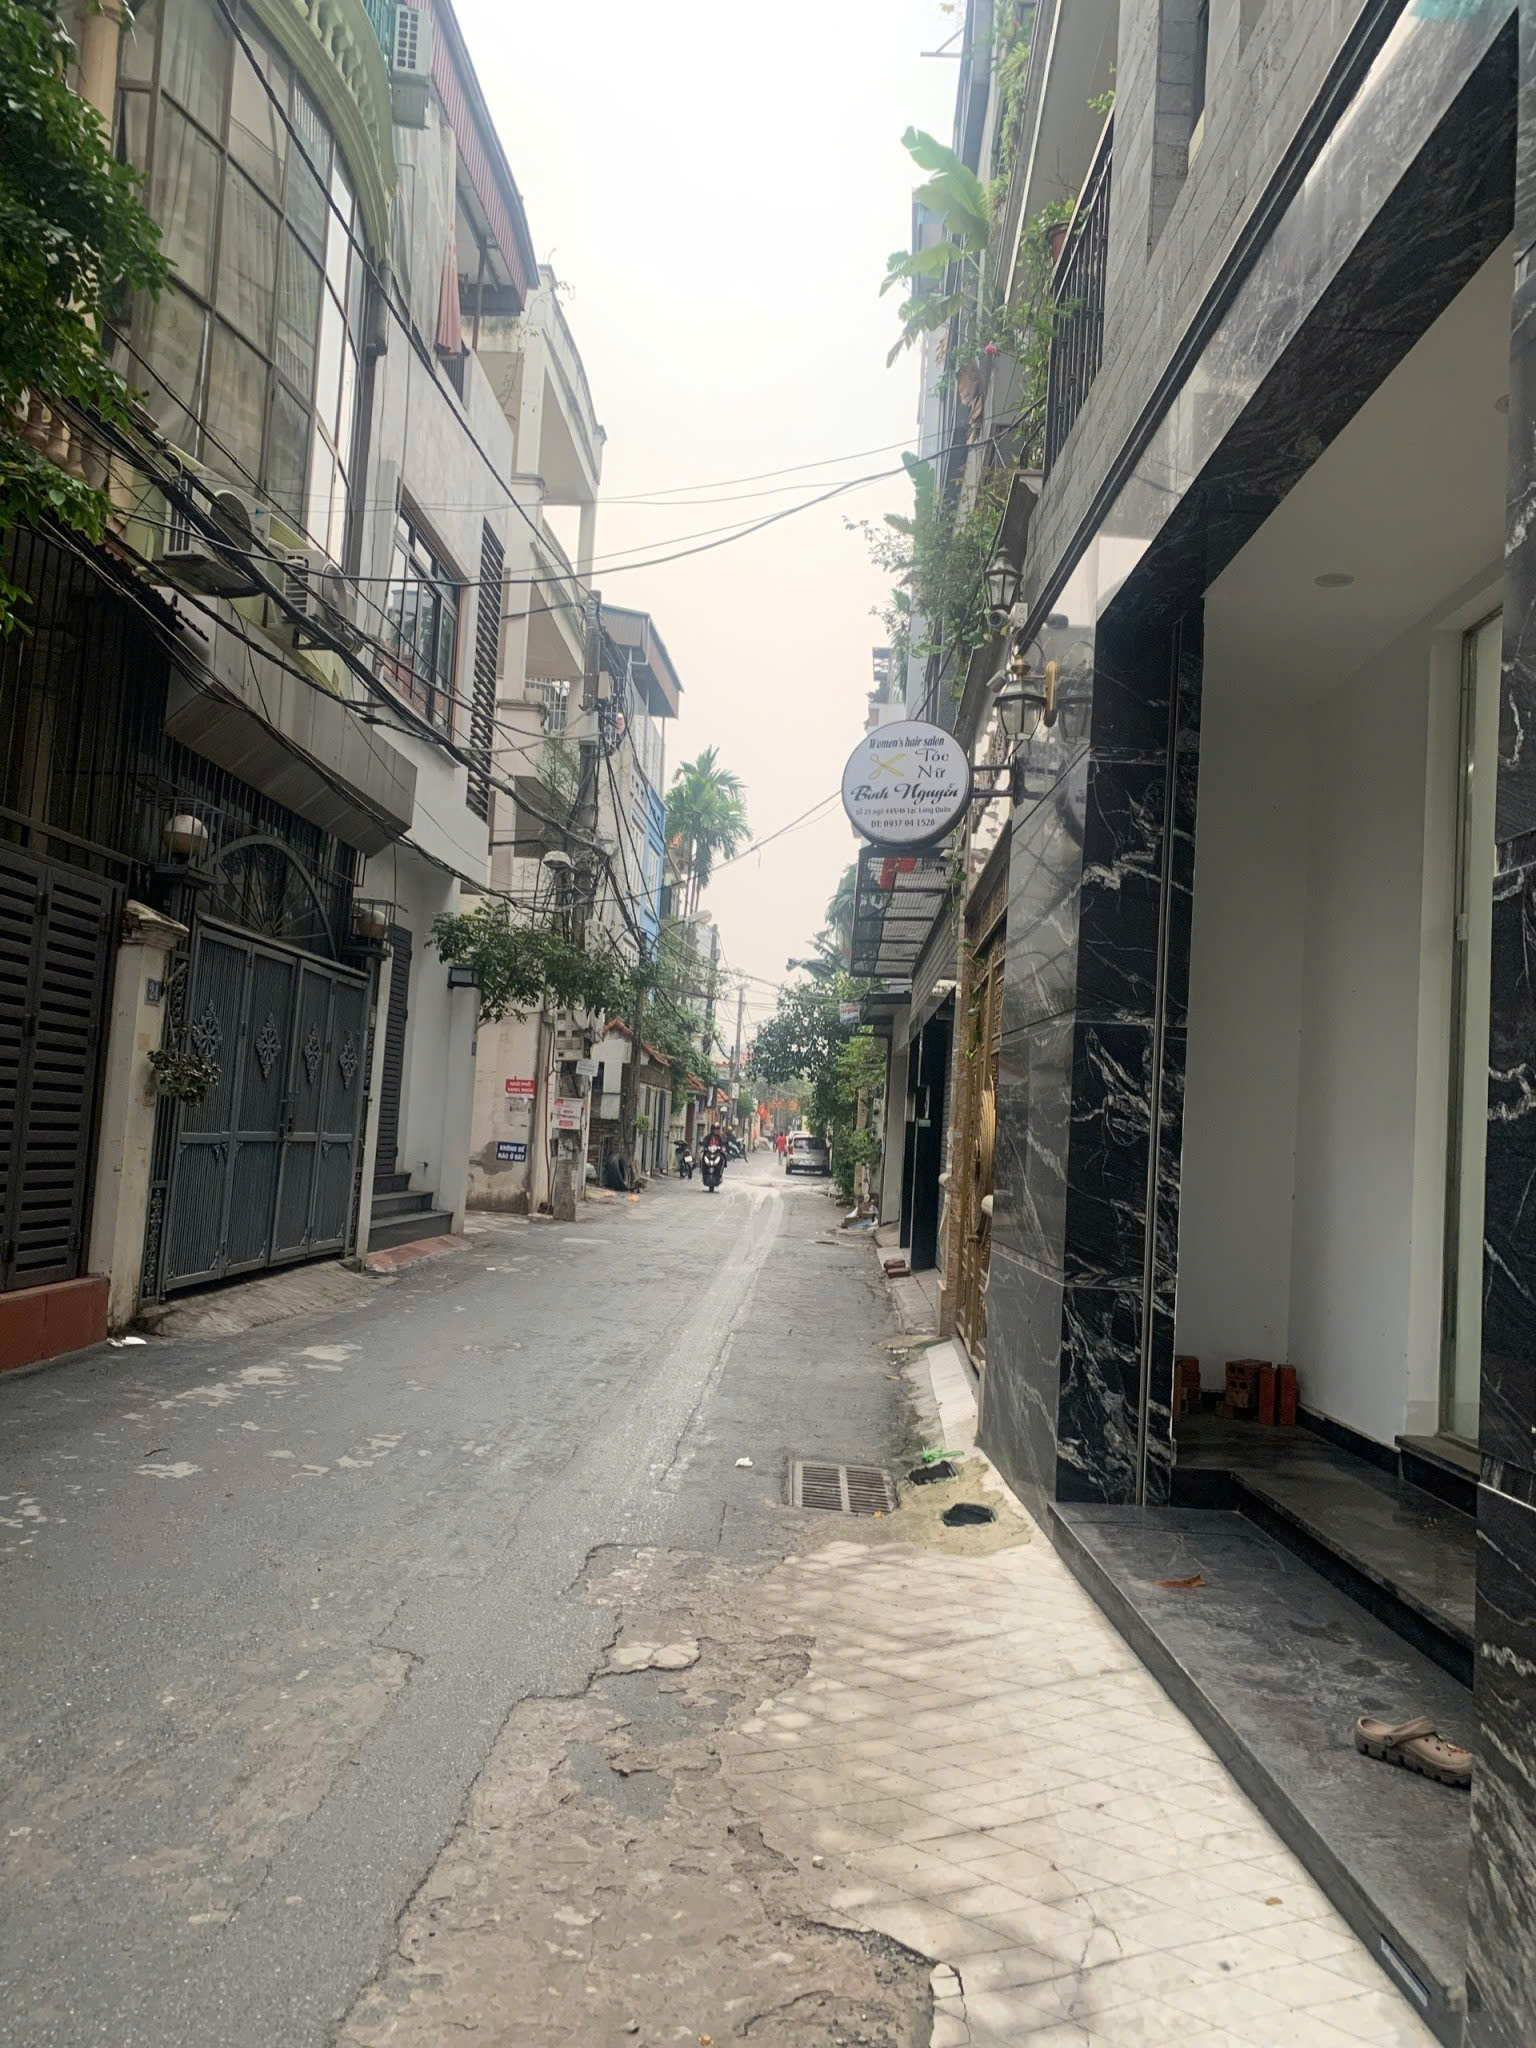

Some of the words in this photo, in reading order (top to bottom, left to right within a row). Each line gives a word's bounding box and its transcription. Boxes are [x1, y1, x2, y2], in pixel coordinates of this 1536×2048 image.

[869, 737, 904, 749] Women's
[905, 736, 923, 747] hair
[923, 736, 945, 746] salon
[915, 748, 950, 762] Tóc
[917, 765, 946, 779] Nữ
